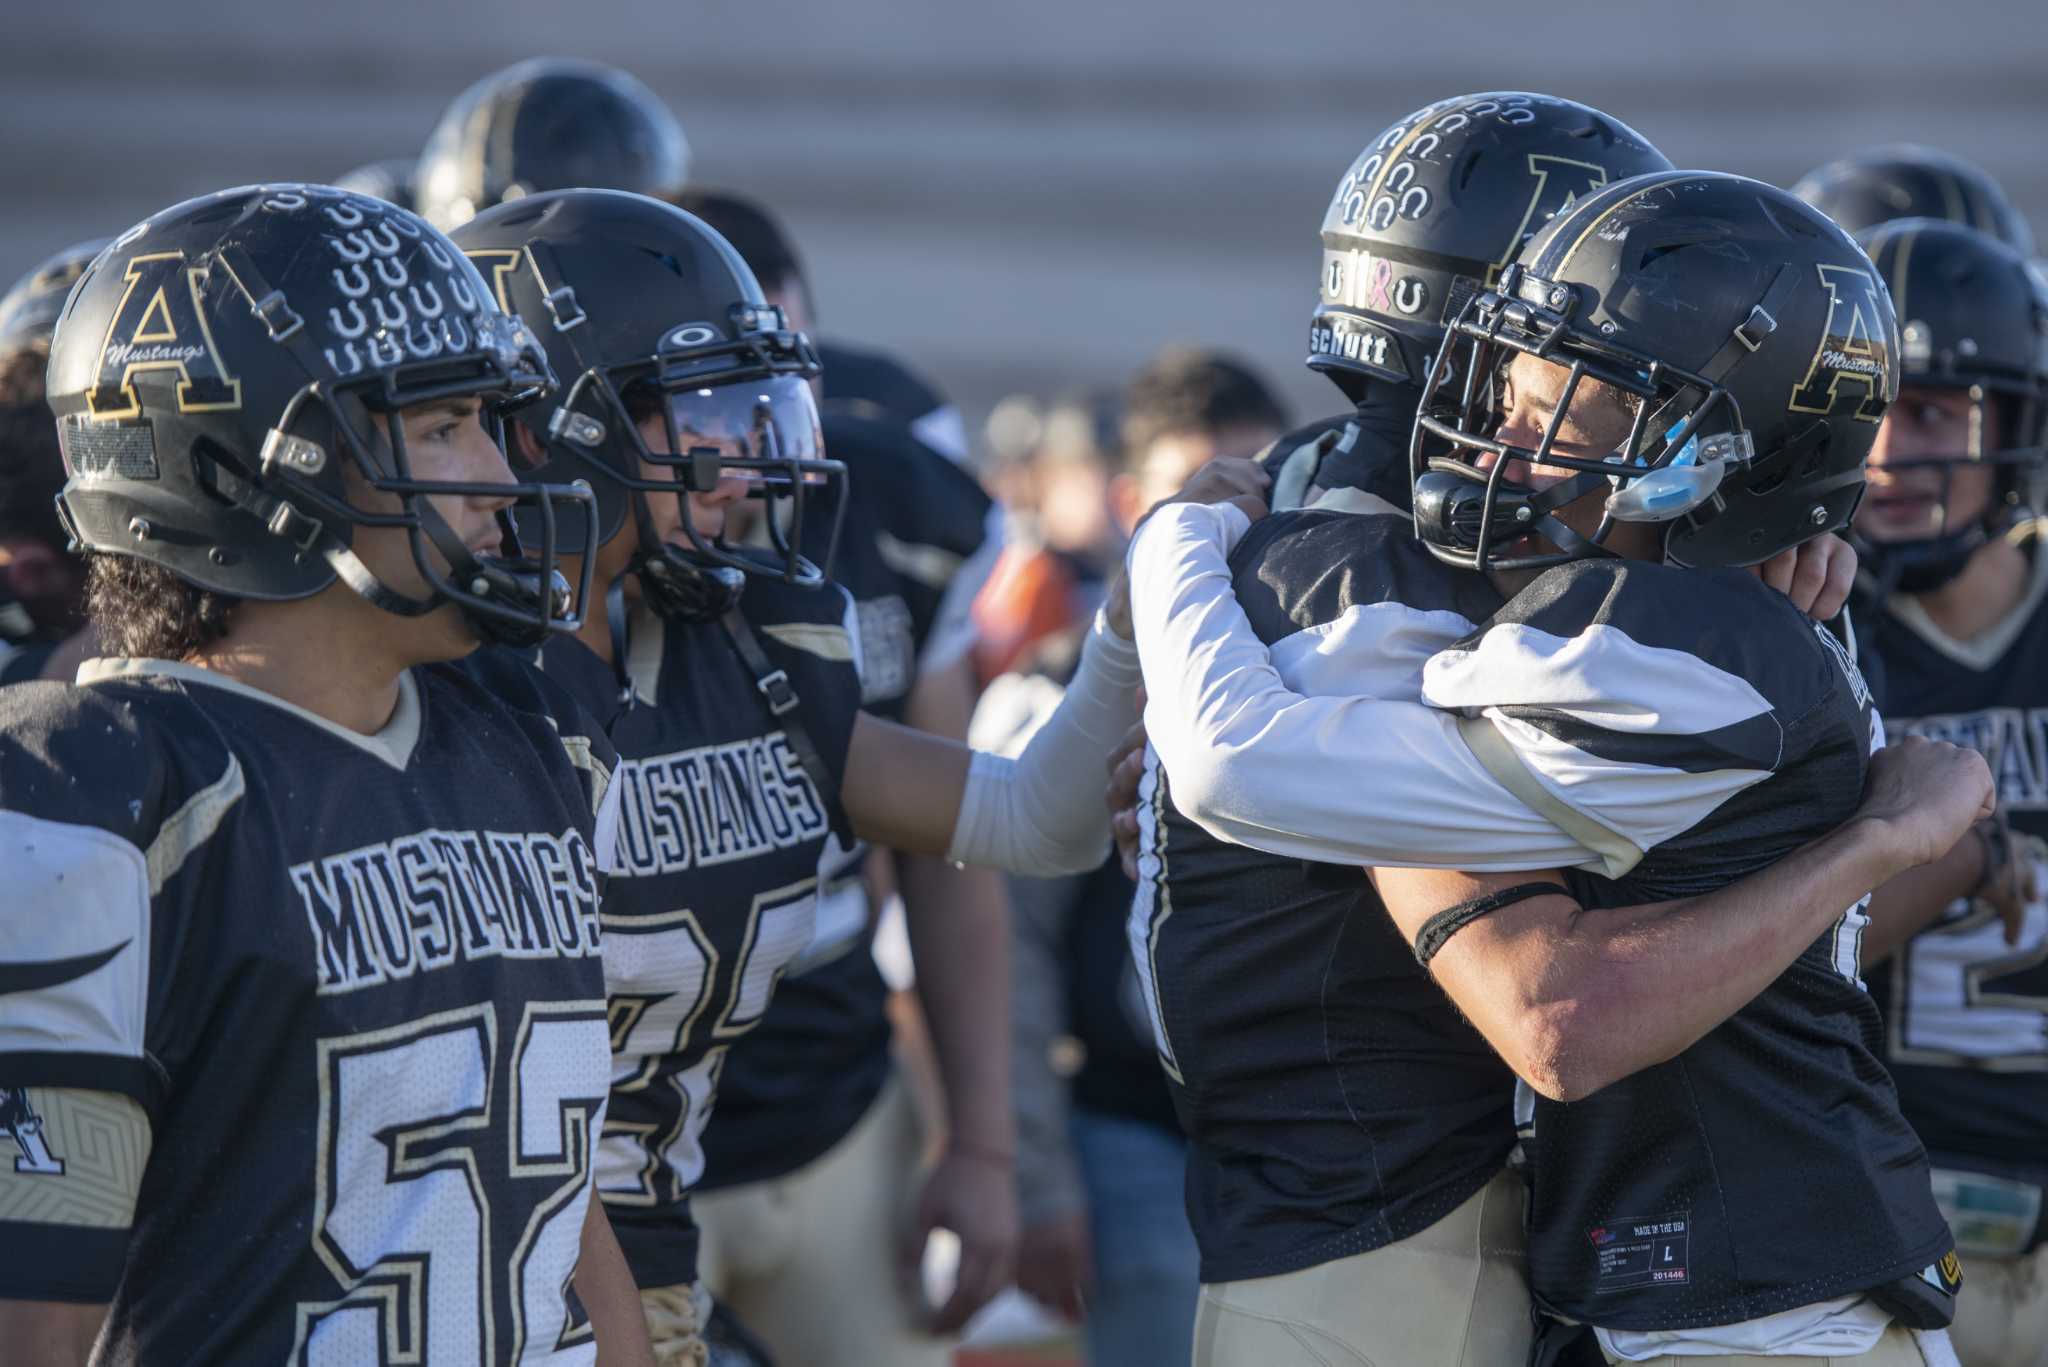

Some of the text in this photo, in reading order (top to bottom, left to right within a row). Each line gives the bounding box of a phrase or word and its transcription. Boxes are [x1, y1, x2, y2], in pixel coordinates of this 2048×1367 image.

[85, 249, 242, 421] A
[107, 341, 205, 366] Mustangs
[1788, 263, 1891, 423] A
[608, 732, 830, 878] USTANGS
[289, 827, 602, 994] MUSTANGS
[1633, 1224, 1652, 1236] MADE
[1664, 1246, 1673, 1262] L
